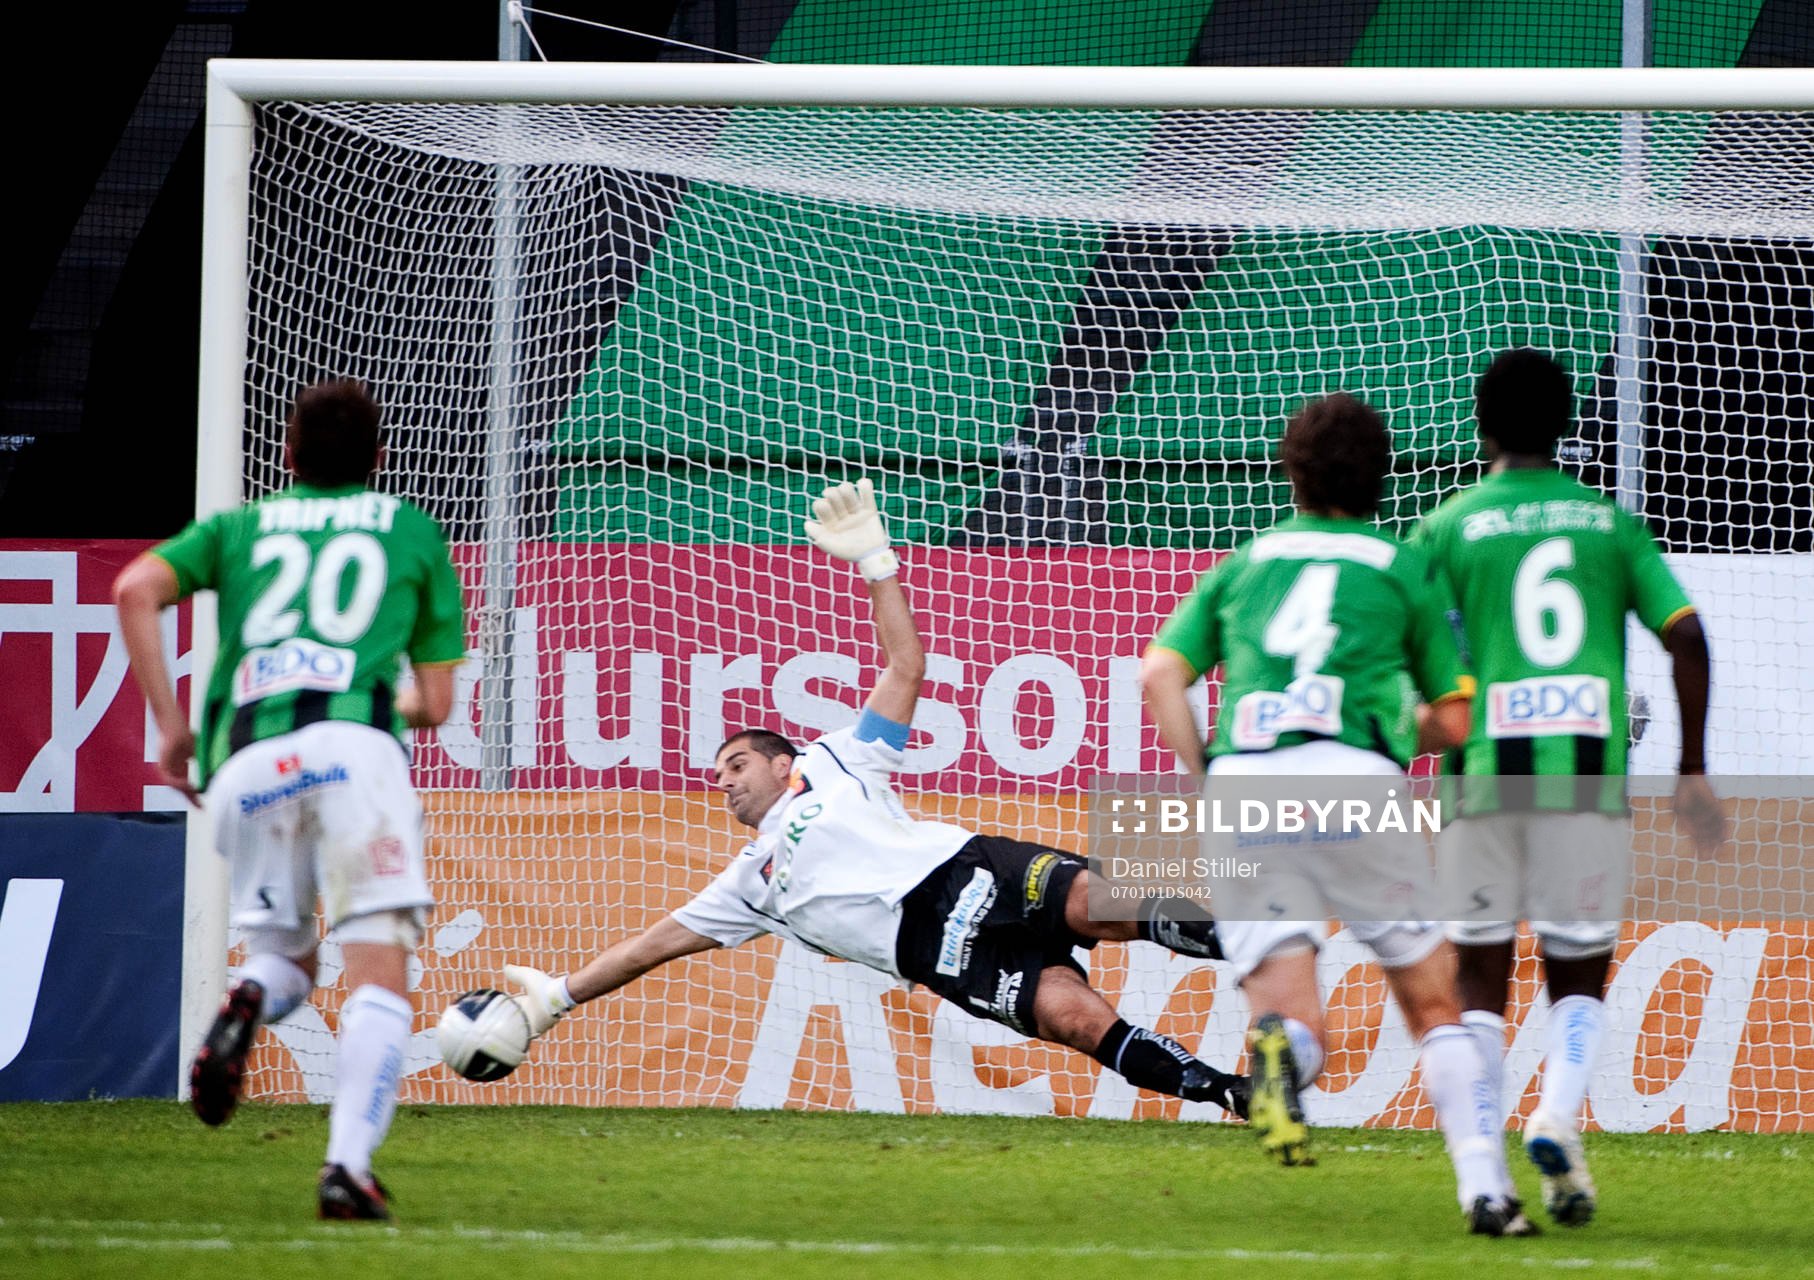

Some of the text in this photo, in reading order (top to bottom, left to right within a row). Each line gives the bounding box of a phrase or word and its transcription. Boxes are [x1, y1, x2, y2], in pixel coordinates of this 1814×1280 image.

[241, 532, 388, 647] 20
[1264, 562, 1341, 677] 4
[1512, 536, 1587, 668] 6
[1257, 682, 1332, 731] BO
[1508, 683, 1602, 719] BDO
